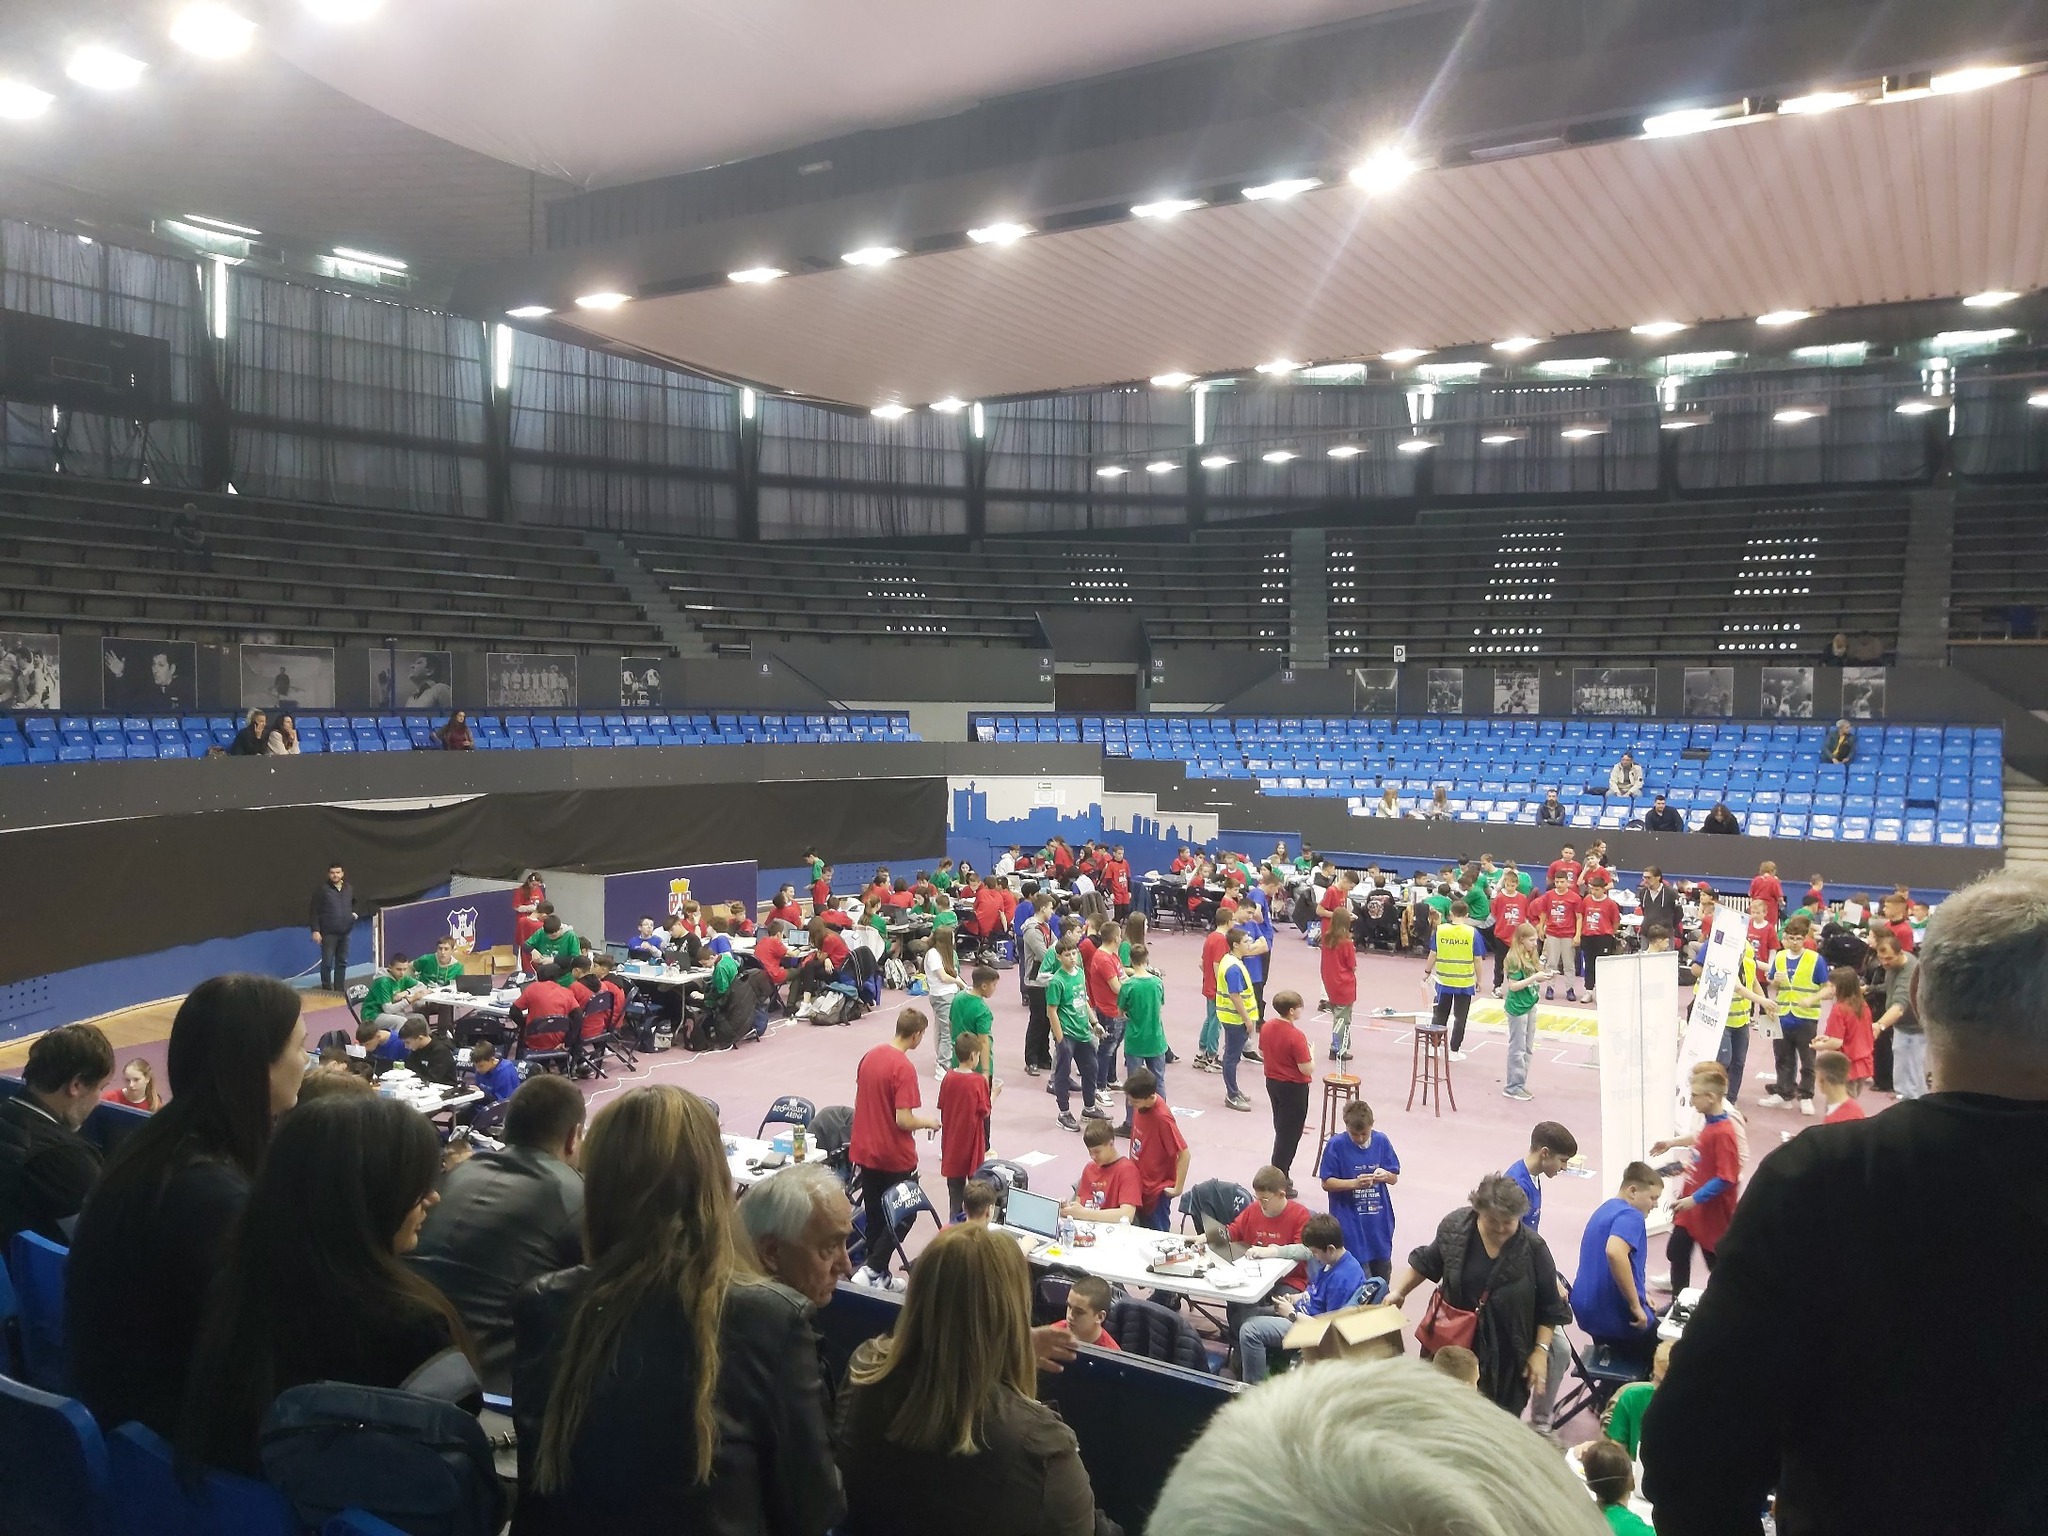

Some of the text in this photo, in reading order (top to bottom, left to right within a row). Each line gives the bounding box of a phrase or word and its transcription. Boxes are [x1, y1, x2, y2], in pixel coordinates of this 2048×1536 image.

[1396, 647, 1404, 657] D
[1043, 658, 1049, 666] 9
[1154, 659, 1164, 667] 10
[762, 663, 769, 672] 8
[1284, 671, 1293, 679] 11
[1440, 937, 1469, 946] СУДИЈА
